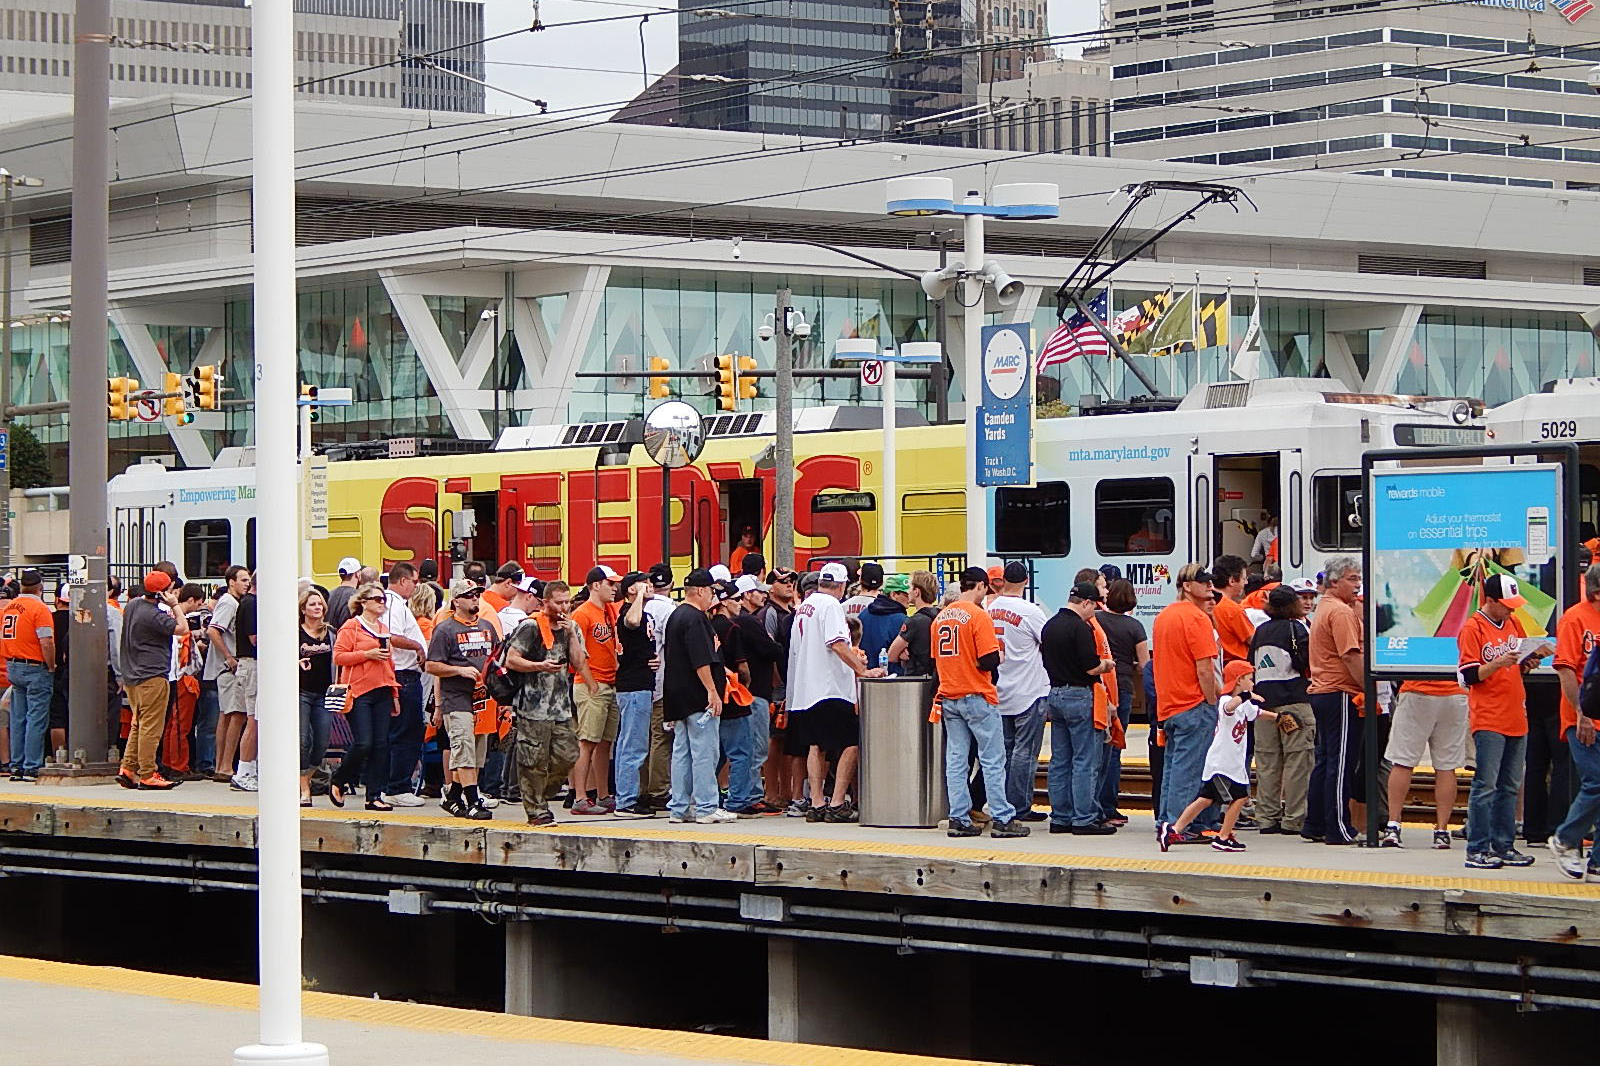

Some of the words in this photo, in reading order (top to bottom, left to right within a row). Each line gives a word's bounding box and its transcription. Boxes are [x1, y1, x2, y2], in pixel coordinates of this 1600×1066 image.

[993, 354, 1021, 369] MARC
[256, 363, 263, 381] 3
[984, 412, 1015, 426] Camden
[984, 428, 1006, 441] Yards
[1541, 420, 1577, 439] 5029
[1068, 445, 1171, 463] mta.maryland.gov
[984, 457, 999, 467] Track
[984, 468, 991, 478] To
[179, 486, 237, 506] Empowering
[1388, 487, 1419, 499] rewards
[1420, 487, 1446, 498] mobile
[380, 455, 863, 588] SEEPYS
[1425, 513, 1447, 525] Adjust
[1448, 515, 1463, 525] your
[1464, 512, 1502, 523] thermostat
[1408, 531, 1418, 539] on
[1420, 525, 1463, 539] essential
[1465, 523, 1489, 541] trips
[1483, 539, 1499, 549] from
[1500, 539, 1521, 549] home
[1126, 563, 1155, 585] MTA
[1134, 584, 1162, 598] aryland
[2, 614, 19, 640] 21
[938, 624, 960, 657] 21
[1387, 636, 1409, 650] BGE
